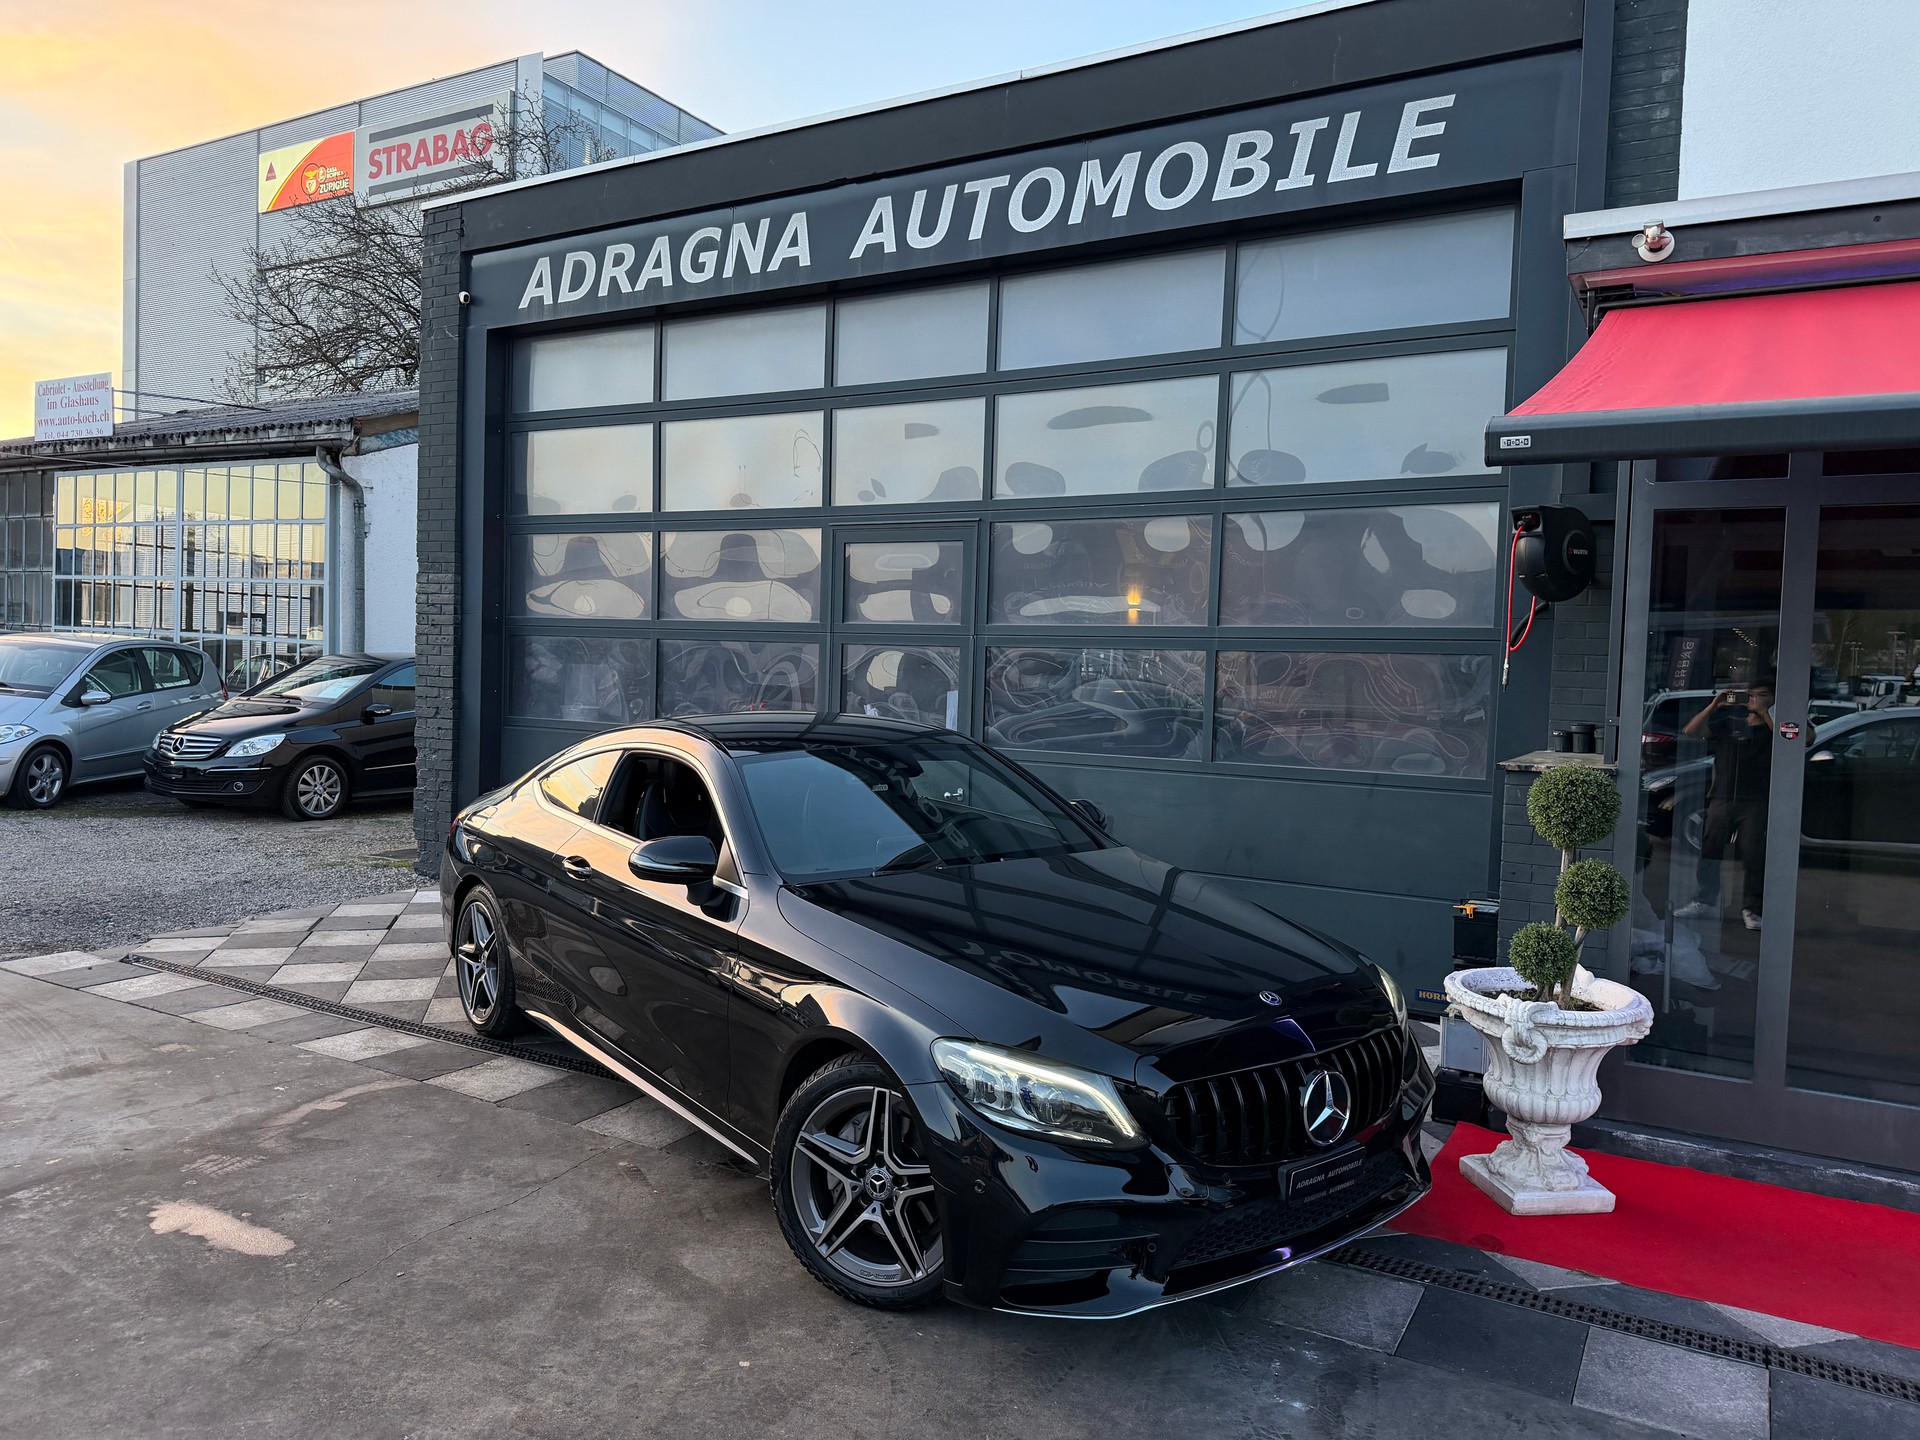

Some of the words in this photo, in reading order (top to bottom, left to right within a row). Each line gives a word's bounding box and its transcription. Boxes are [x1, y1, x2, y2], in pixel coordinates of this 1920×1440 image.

[368, 122, 494, 180] STRABAG
[519, 211, 811, 309] ADRAGNA
[848, 94, 1456, 260] AUTOMOBILE
[38, 383, 66, 397] Cabriolet
[72, 378, 109, 392] Ausstellung
[47, 398, 57, 410] im
[60, 394, 99, 409] Glashaus
[38, 410, 109, 428] www.auto-koch.ch
[57, 430, 69, 438] 044
[71, 429, 82, 438] 730
[85, 428, 93, 436] 36
[96, 427, 104, 435] 36
[1296, 1173, 1325, 1189] ADRAGNA
[1327, 1158, 1363, 1178] AUTOMOBILE
